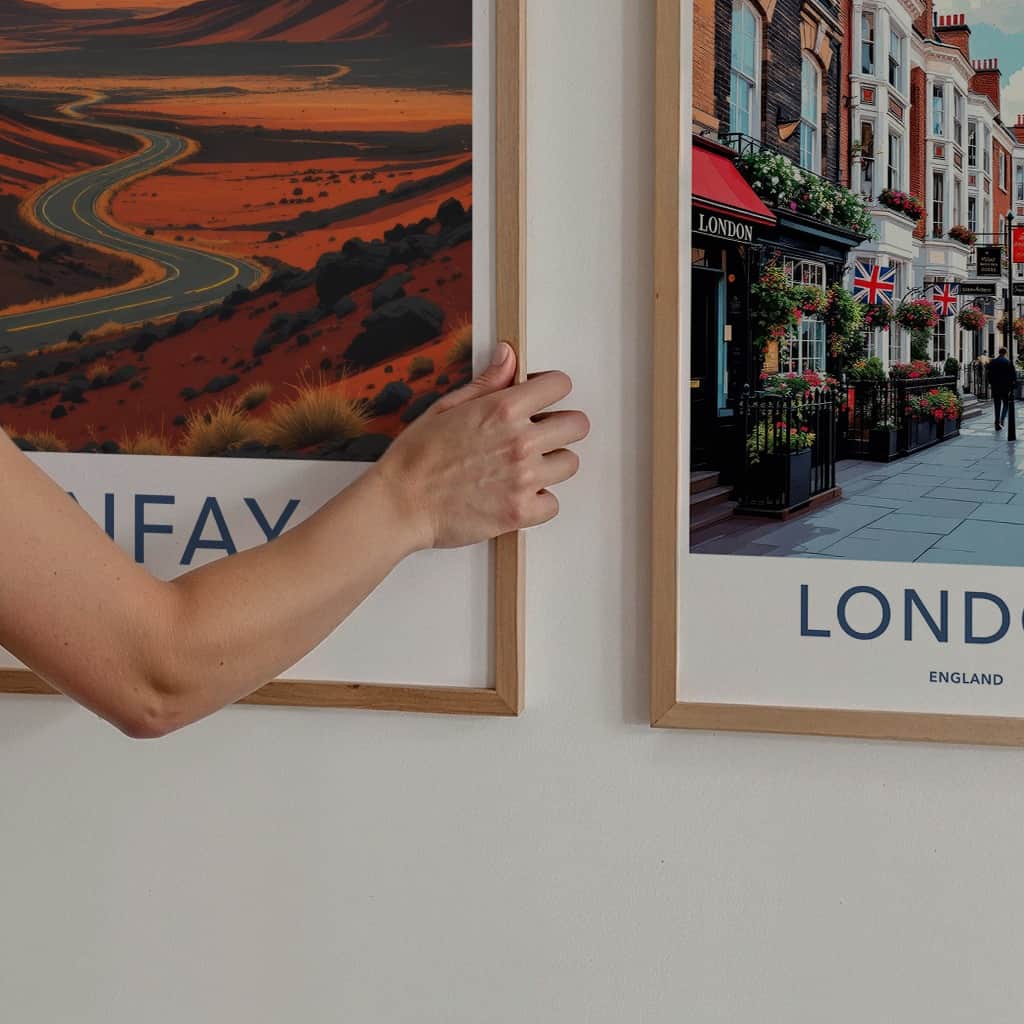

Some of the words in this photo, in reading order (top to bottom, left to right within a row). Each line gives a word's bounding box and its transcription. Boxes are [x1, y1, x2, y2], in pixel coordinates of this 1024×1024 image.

[698, 213, 753, 242] LONDON
[800, 584, 1024, 645] LOND
[929, 671, 1004, 686] ENGLAND
